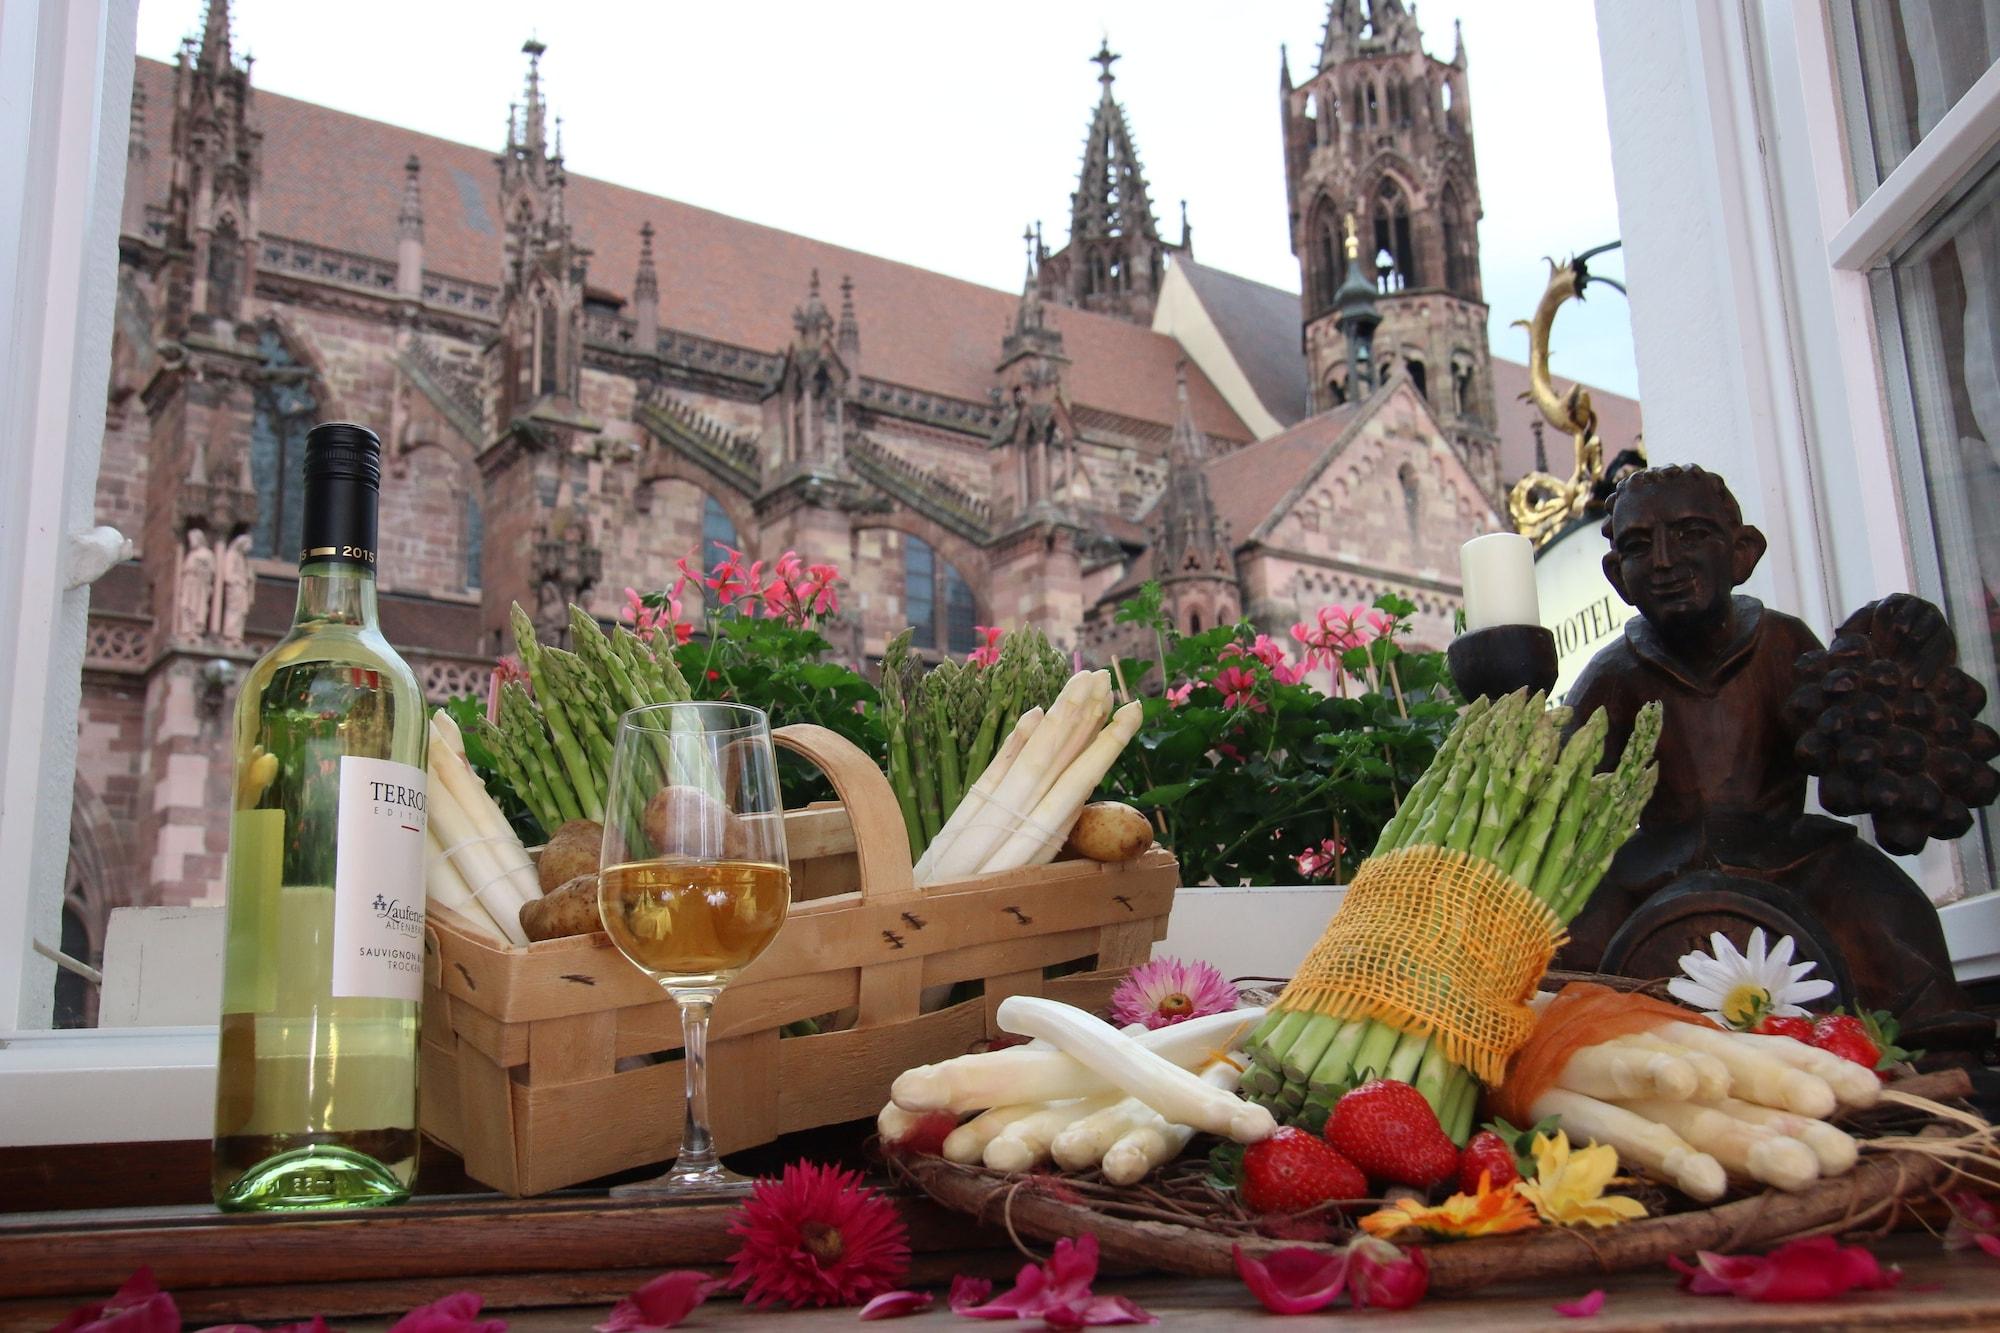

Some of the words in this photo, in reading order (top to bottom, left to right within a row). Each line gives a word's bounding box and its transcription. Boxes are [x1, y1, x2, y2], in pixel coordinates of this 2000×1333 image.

[342, 545, 375, 564] 2015
[370, 781, 427, 813] TERROI
[359, 946, 416, 961] SAUVIGNON
